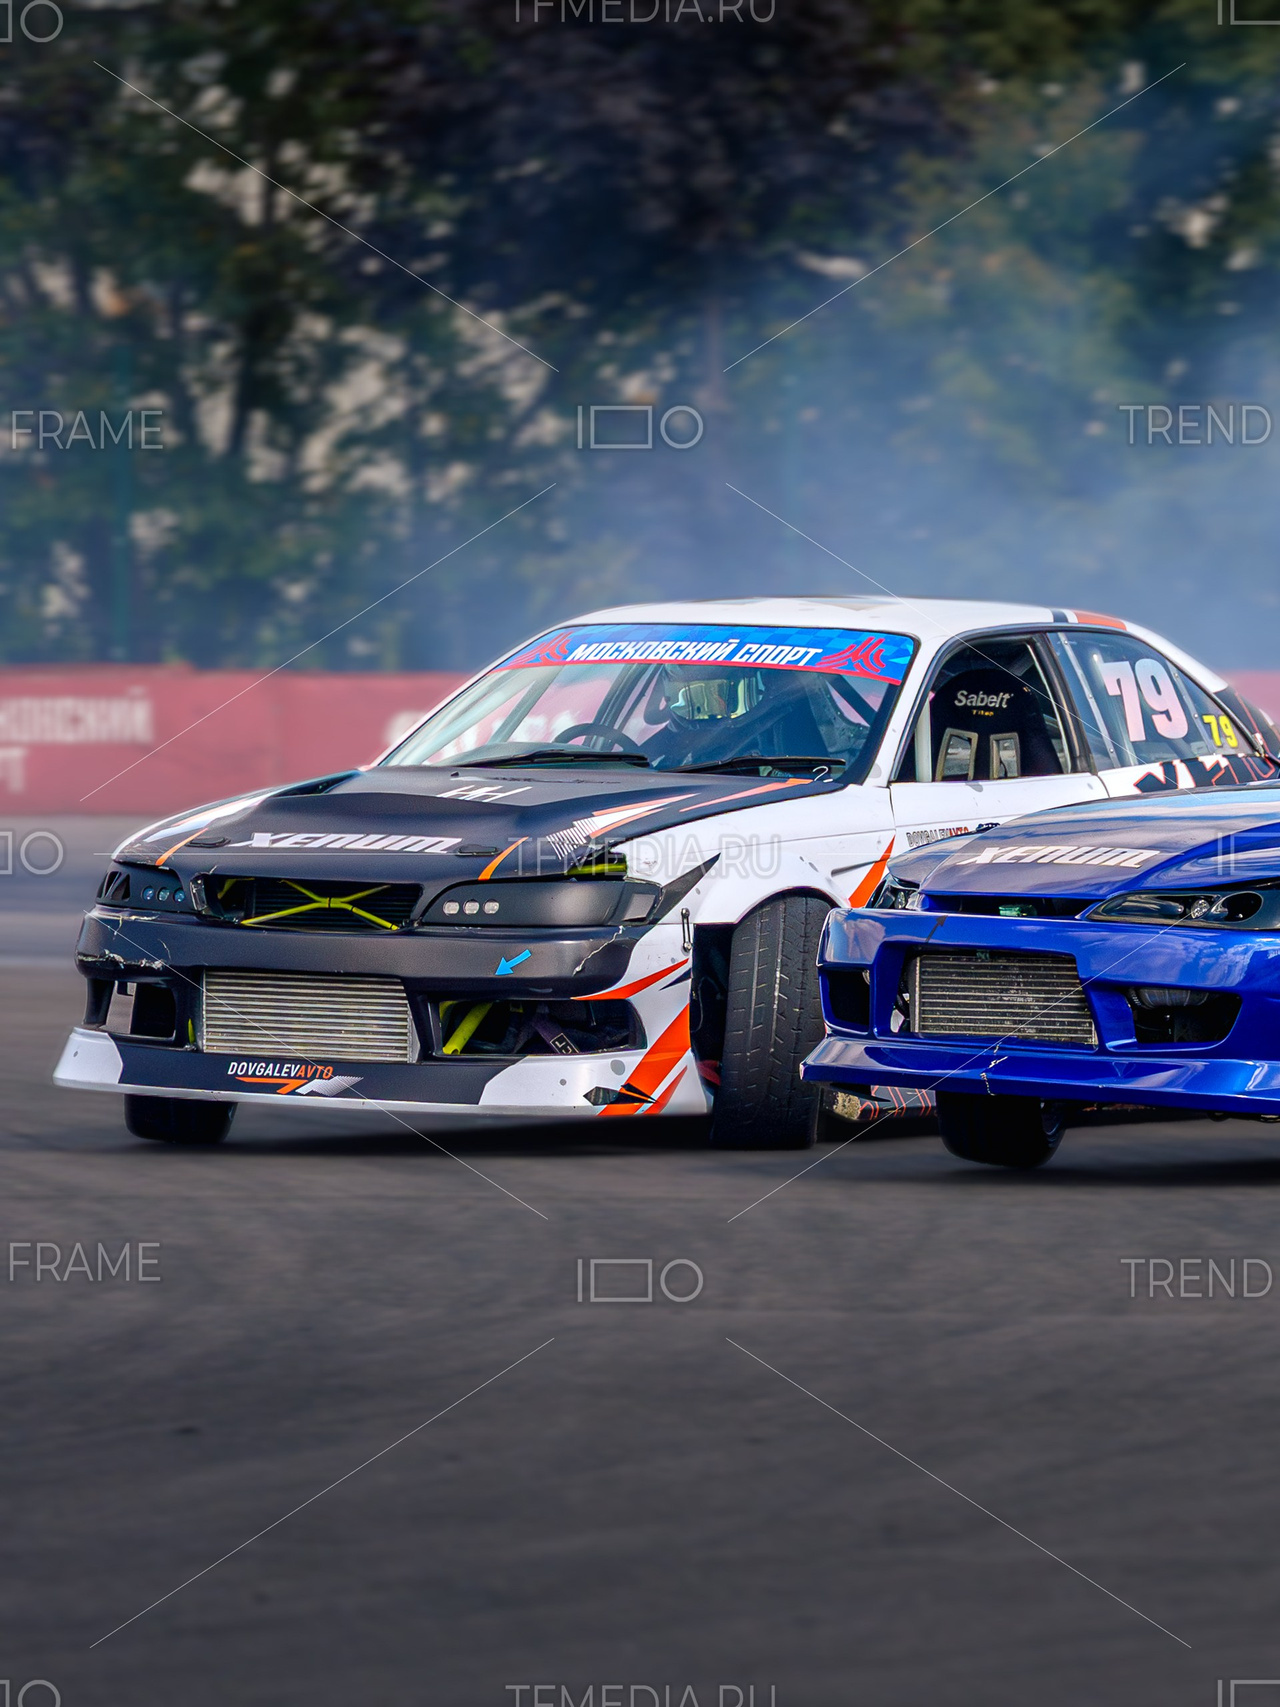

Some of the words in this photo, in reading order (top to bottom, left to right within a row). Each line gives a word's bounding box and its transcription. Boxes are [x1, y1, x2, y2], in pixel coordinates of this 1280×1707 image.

[568, 638, 735, 662] МОСКОВСКИЙ
[733, 644, 824, 667] СПОРТ
[954, 690, 1011, 708] Sabelt
[1102, 658, 1189, 742] 79
[1202, 714, 1239, 748] 79
[228, 831, 463, 854] XENUM
[956, 845, 1161, 869] XENUM
[227, 1061, 334, 1079] DOVGALEVAVTO
